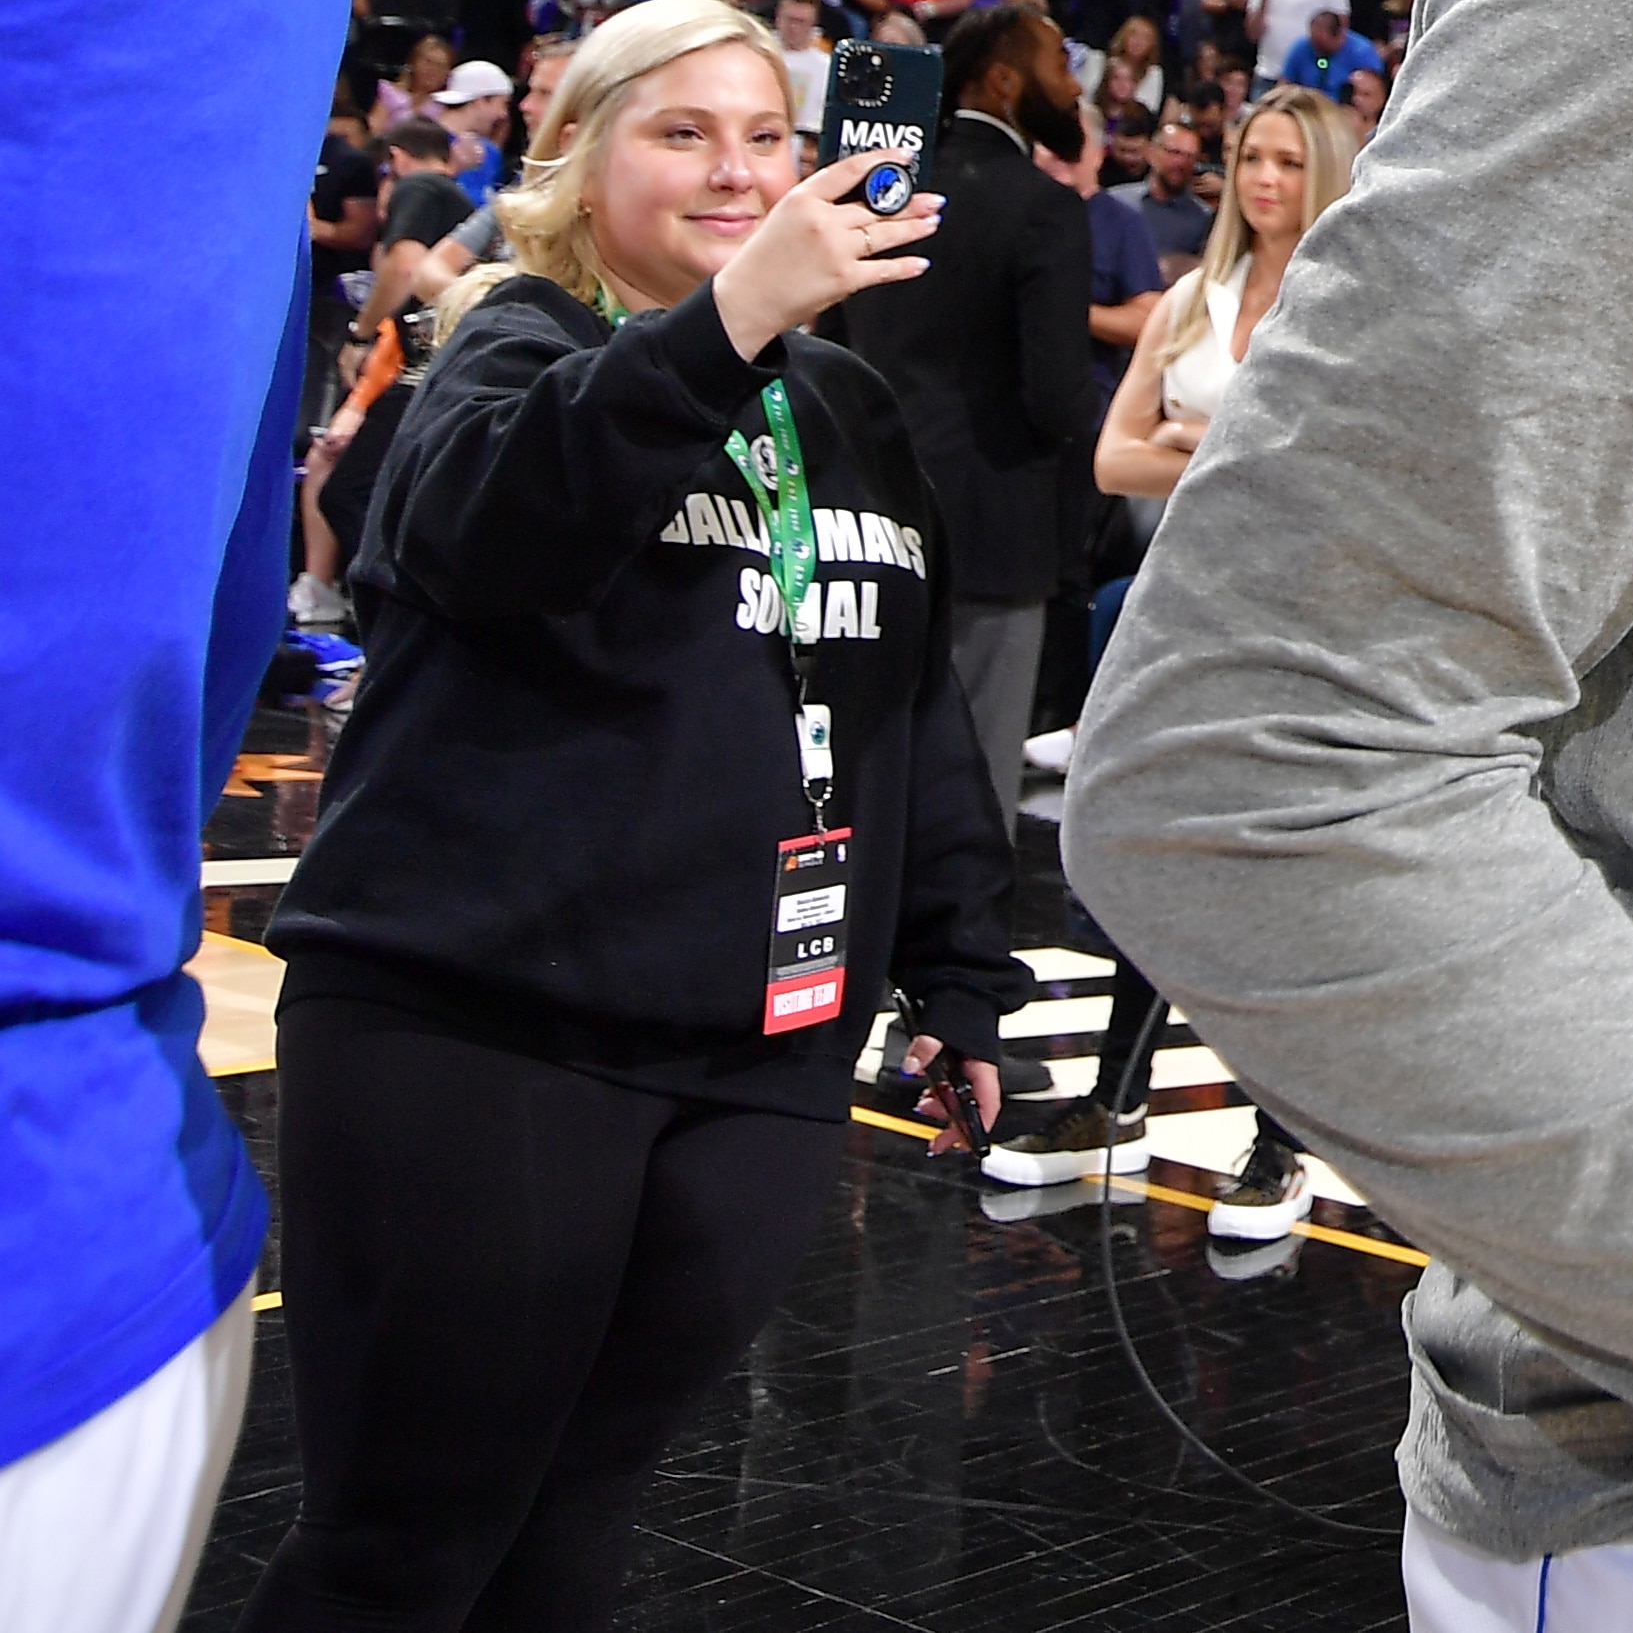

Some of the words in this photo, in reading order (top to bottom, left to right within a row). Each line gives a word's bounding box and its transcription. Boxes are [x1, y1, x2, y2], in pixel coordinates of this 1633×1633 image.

[840, 119, 924, 152] MAVS
[811, 508, 926, 580] MAVS
[797, 936, 834, 959] LCB
